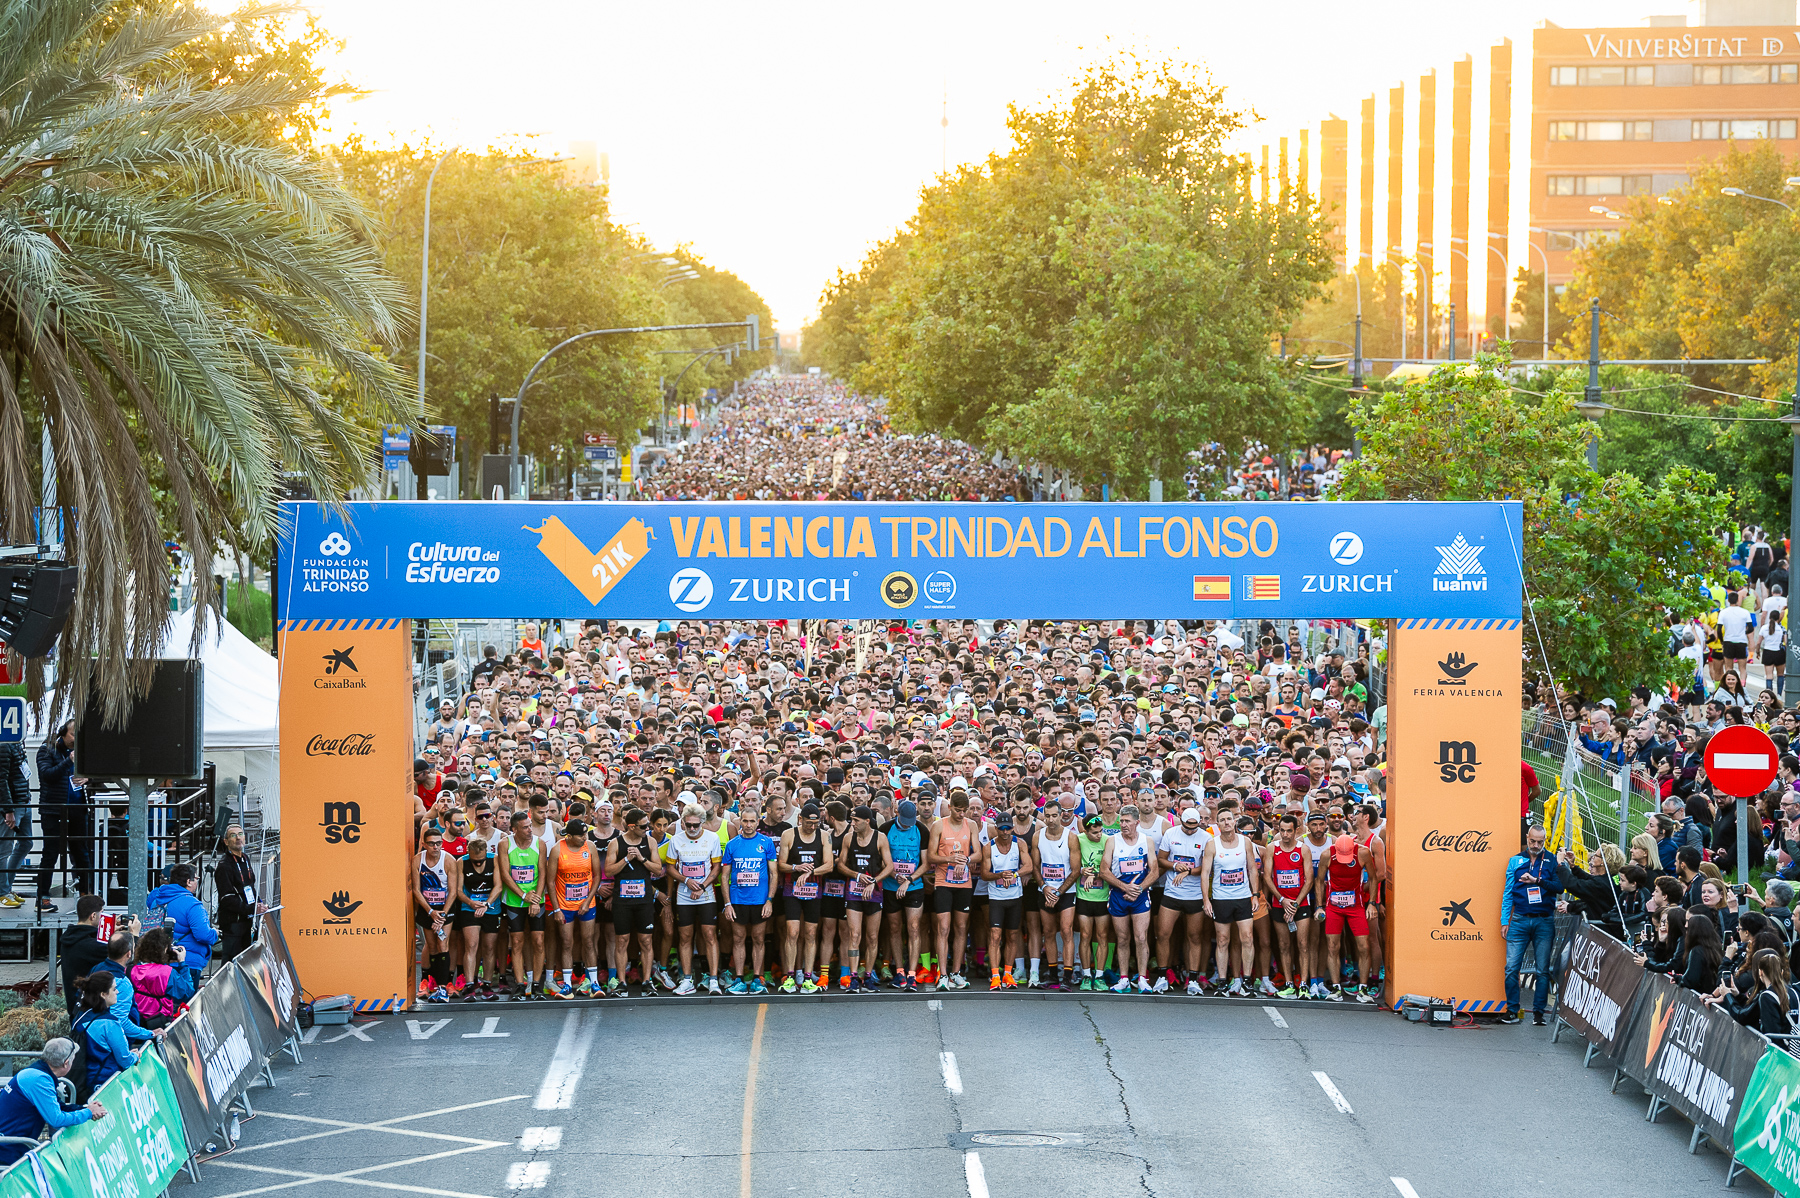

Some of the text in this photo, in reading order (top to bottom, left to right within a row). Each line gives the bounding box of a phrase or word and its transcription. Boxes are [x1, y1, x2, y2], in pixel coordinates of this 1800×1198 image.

[1584, 34, 1748, 58] VNIVERSITAT
[669, 516, 1279, 558] VALENCIA TRINIDAD ALFONSO
[407, 542, 500, 562] Cultura del
[303, 557, 369, 567] FUNDACIÓN
[592, 540, 634, 589] 21K
[303, 569, 369, 580] TRINIDAD
[405, 562, 500, 583] Esfuerzo
[303, 581, 369, 592] ALFONSO
[728, 578, 850, 602] ZURICH
[1301, 574, 1393, 592] ZURICH
[314, 679, 367, 689] CaixaBank
[1413, 688, 1503, 697] FERIA VALENCIA
[0, 706, 20, 735] 4
[735, 861, 761, 869] ITALIA
[299, 927, 388, 936] FERIA VALENCIA
[1430, 930, 1484, 941] CaixaBank
